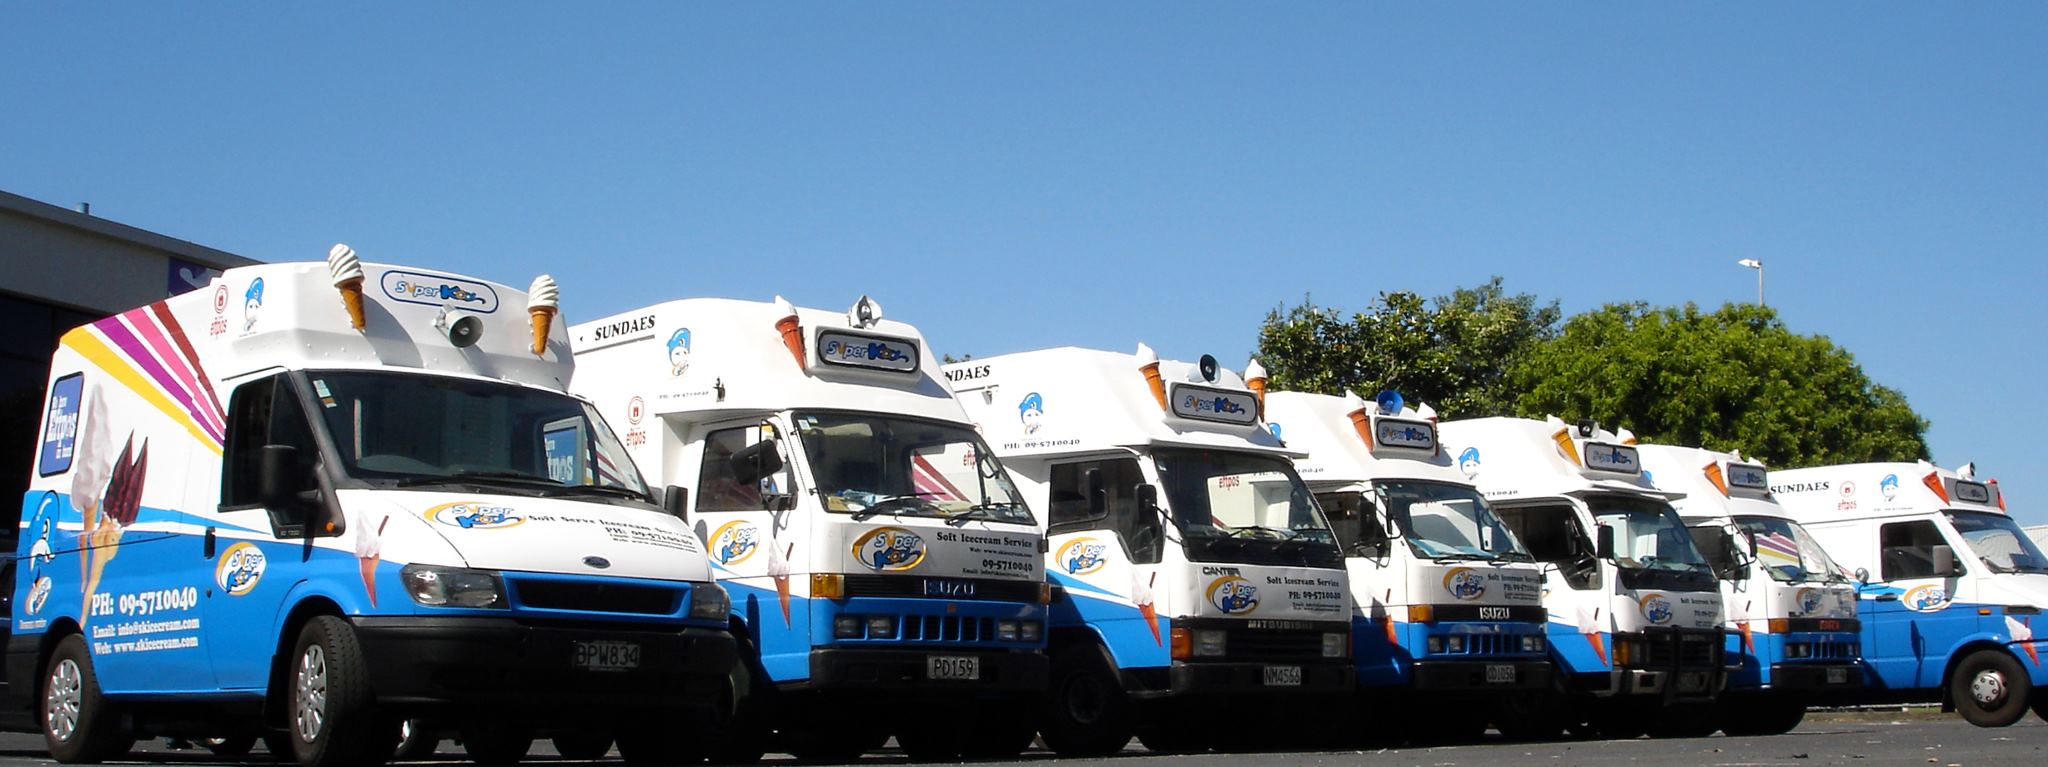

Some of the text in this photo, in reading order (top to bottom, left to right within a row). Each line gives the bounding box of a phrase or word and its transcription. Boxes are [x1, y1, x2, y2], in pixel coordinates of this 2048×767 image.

[395, 280, 440, 298] Super
[594, 314, 655, 341] SUNDAES
[826, 340, 868, 360] Super
[1770, 481, 1830, 495] SUNDAES
[452, 503, 515, 517] Super
[873, 531, 921, 551] Super
[936, 531, 1033, 549] Soft Icecream Service
[982, 558, 1033, 573] 09-5710040
[1202, 566, 1242, 577] CANTER
[91, 586, 199, 617] PH: 09-5710040
[1479, 606, 1510, 619] ISUZU
[93, 618, 200, 639] Email: info@skicecream.com
[93, 641, 112, 655] Web:
[576, 644, 640, 666] BPW834
[934, 658, 974, 677] PD159
